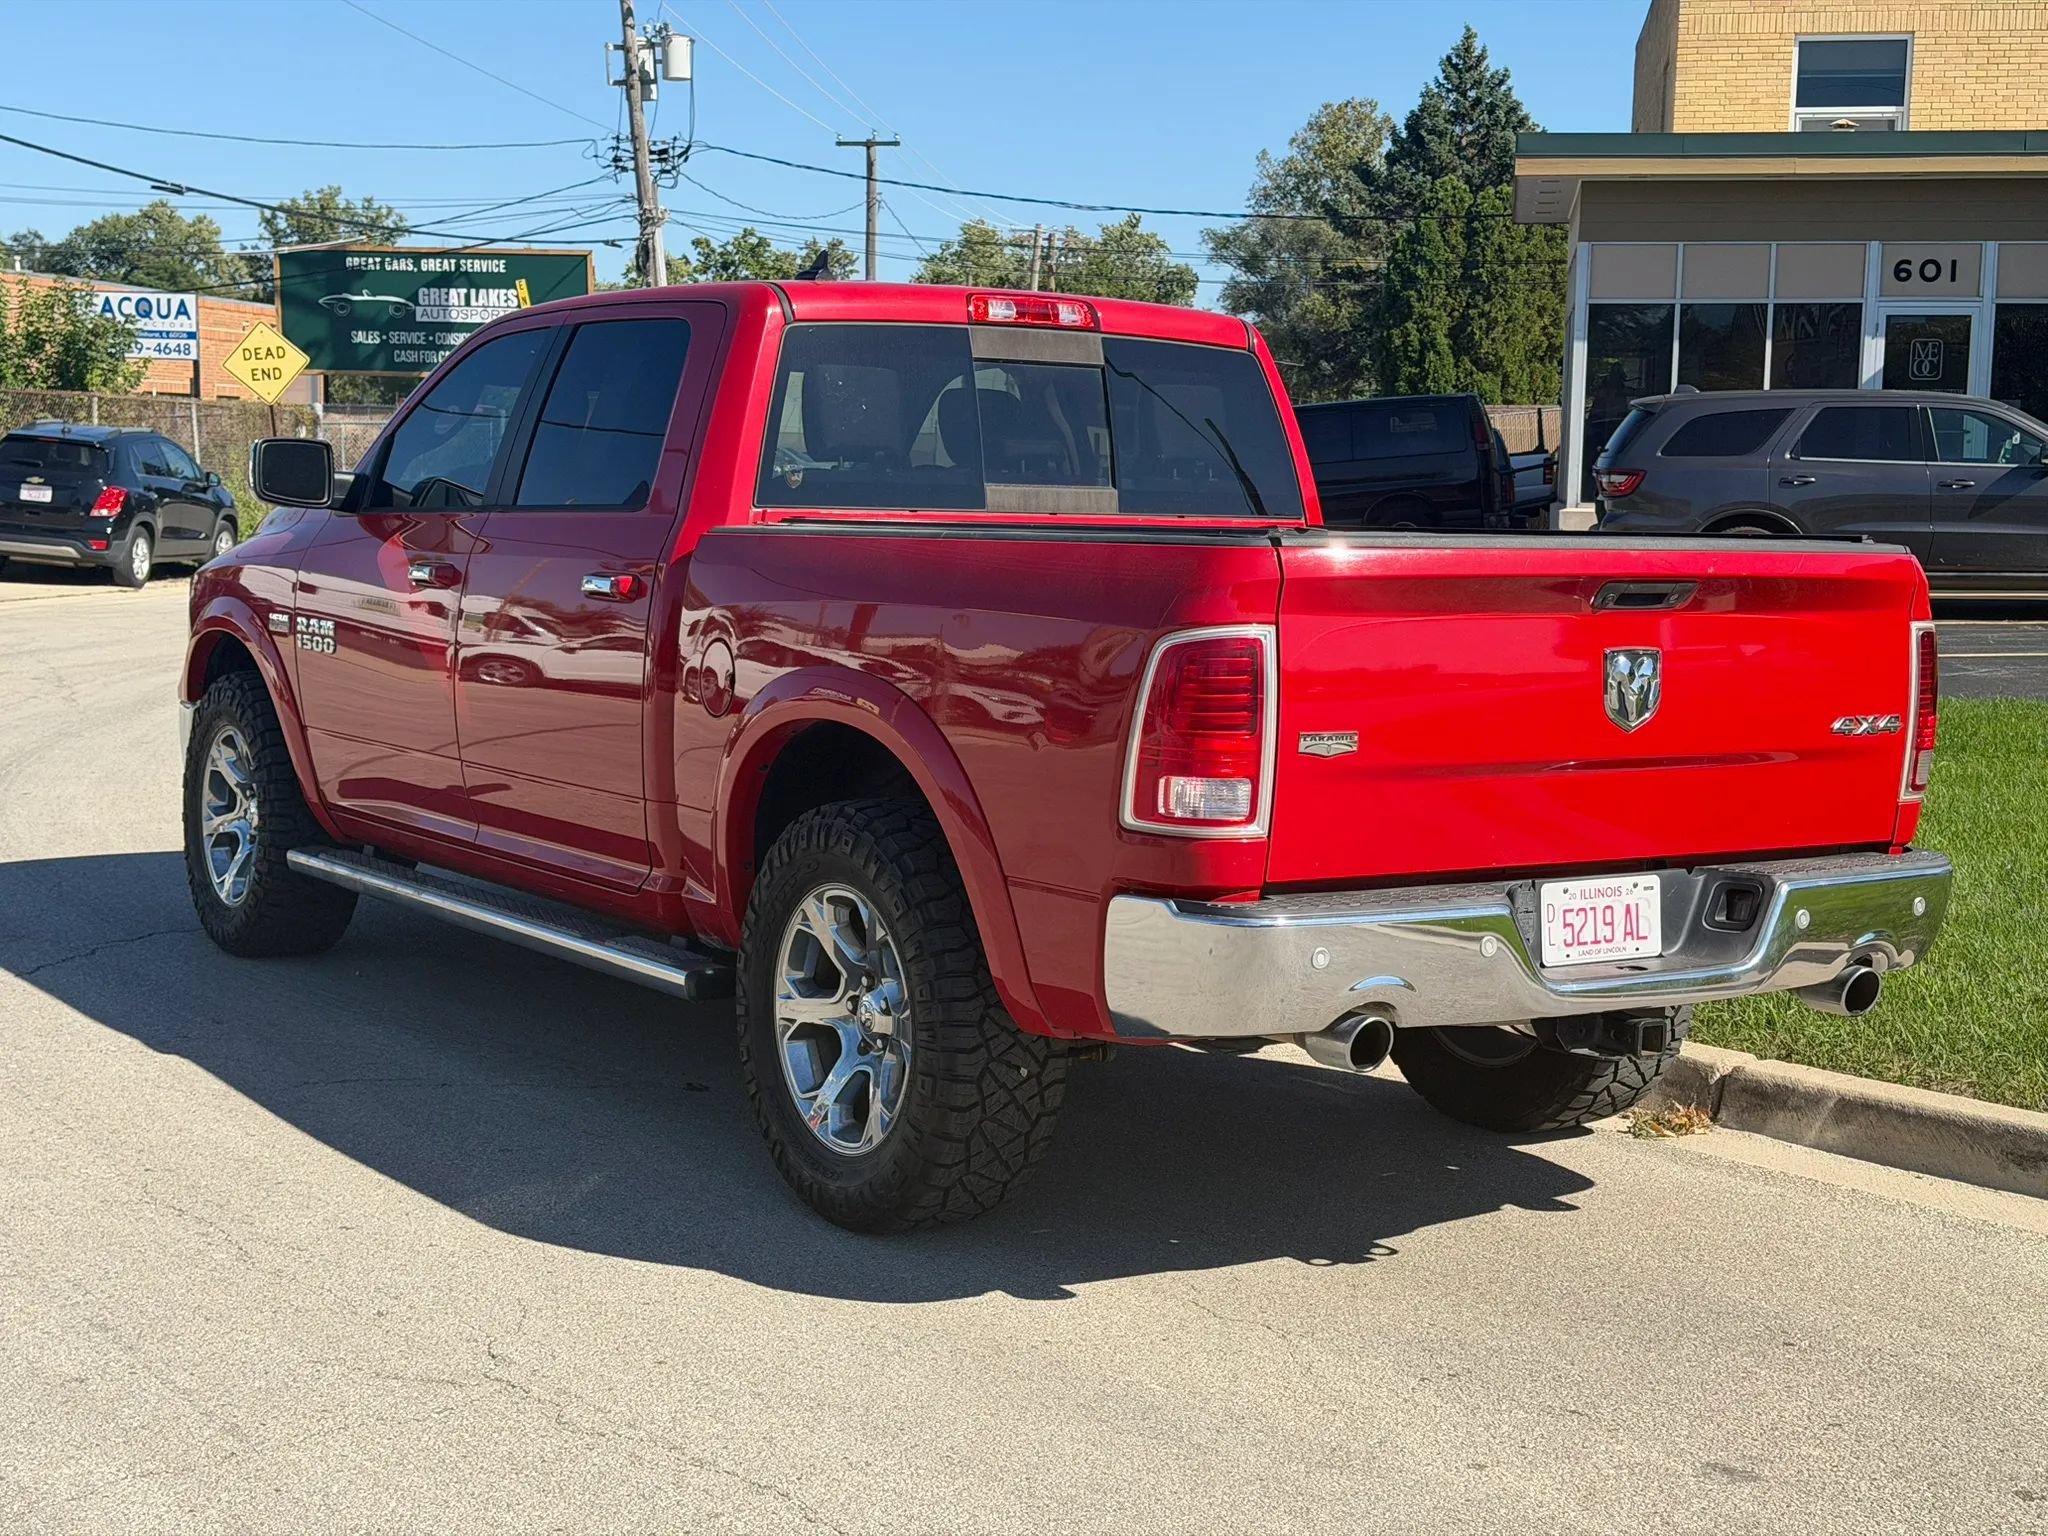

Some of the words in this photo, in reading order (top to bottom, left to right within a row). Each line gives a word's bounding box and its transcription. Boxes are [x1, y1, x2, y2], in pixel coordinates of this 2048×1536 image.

[345, 256, 382, 271] GREAT
[384, 257, 418, 273] CARS,
[420, 258, 456, 273] GREAT
[459, 259, 507, 274] SERVICE
[1893, 258, 1957, 283] 601
[418, 287, 467, 306] GREAT
[470, 289, 519, 307] LAKES
[351, 330, 380, 344] SALES
[389, 331, 427, 345] SERVICE
[134, 342, 191, 356] 9-4648
[242, 346, 286, 361] DEAD
[394, 350, 419, 362] CASH
[420, 351, 437, 363] FOR
[251, 367, 282, 381] END
[296, 617, 336, 638] RAM
[296, 634, 336, 653] 1500
[1579, 886, 1623, 900] ILLINOIS
[1563, 905, 1614, 947] 5219
[1624, 903, 1648, 942] AL
[1602, 946, 1627, 954] LINCOLN
